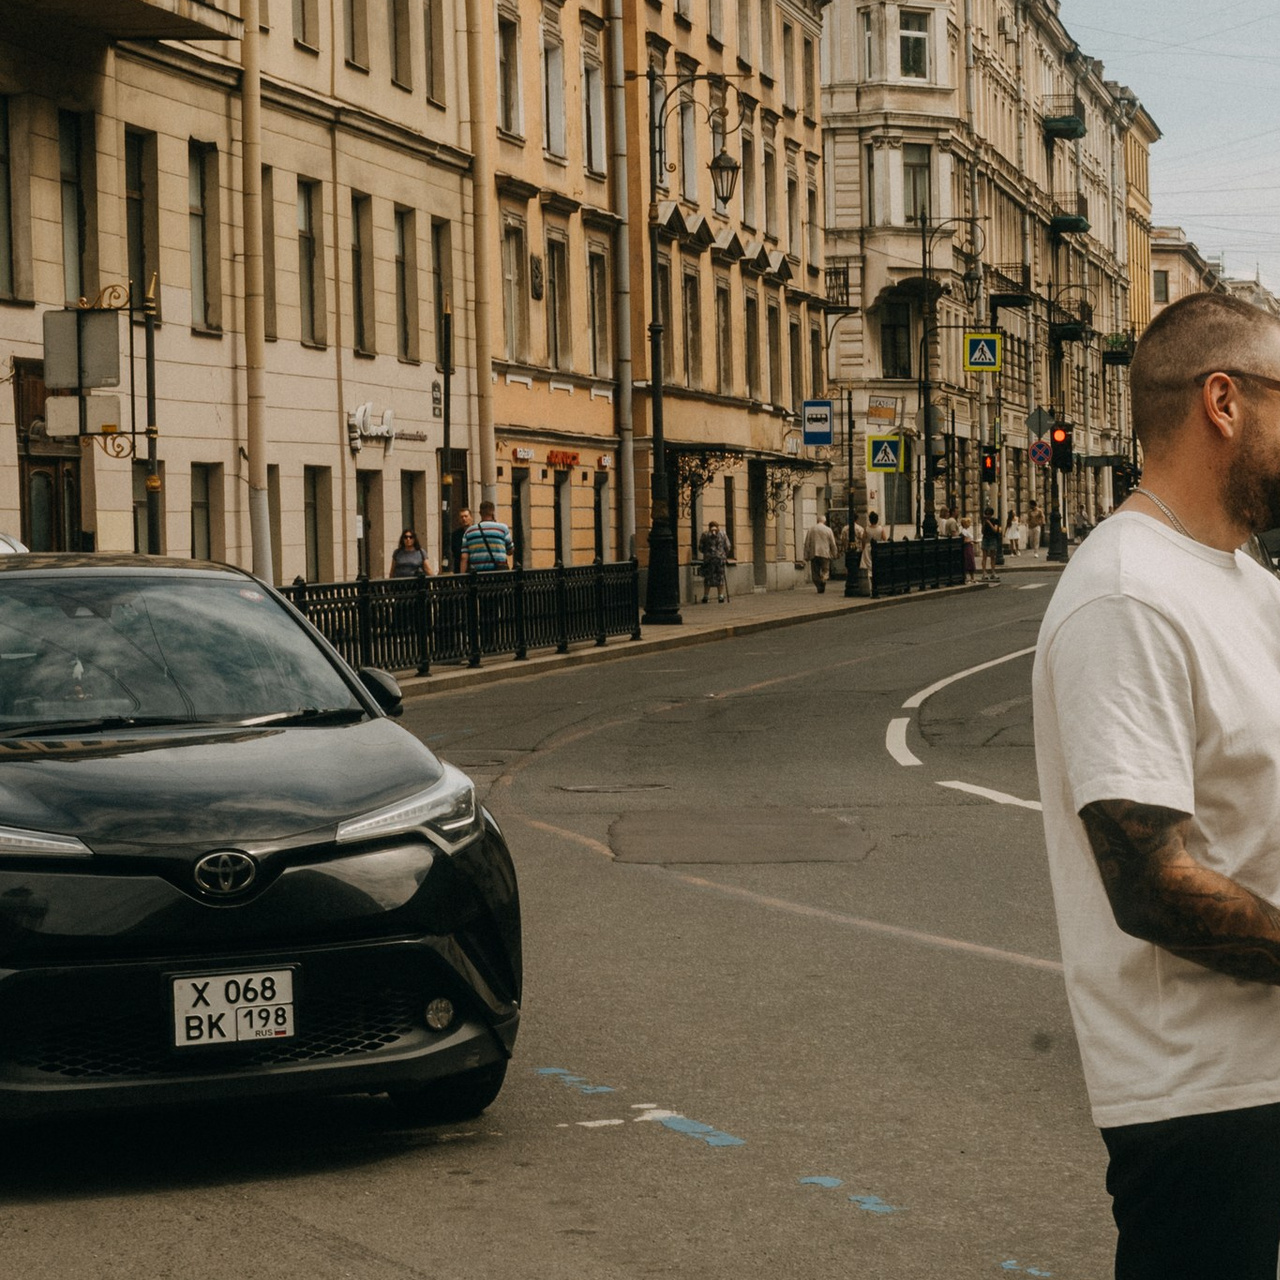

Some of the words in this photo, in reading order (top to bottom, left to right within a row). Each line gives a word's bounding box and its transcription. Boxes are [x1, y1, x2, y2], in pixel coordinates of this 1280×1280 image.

[191, 982, 210, 1008] X
[224, 977, 276, 1004] 068
[185, 1013, 226, 1040] BK
[243, 1007, 287, 1029] 198
[255, 1028, 273, 1037] RUS
